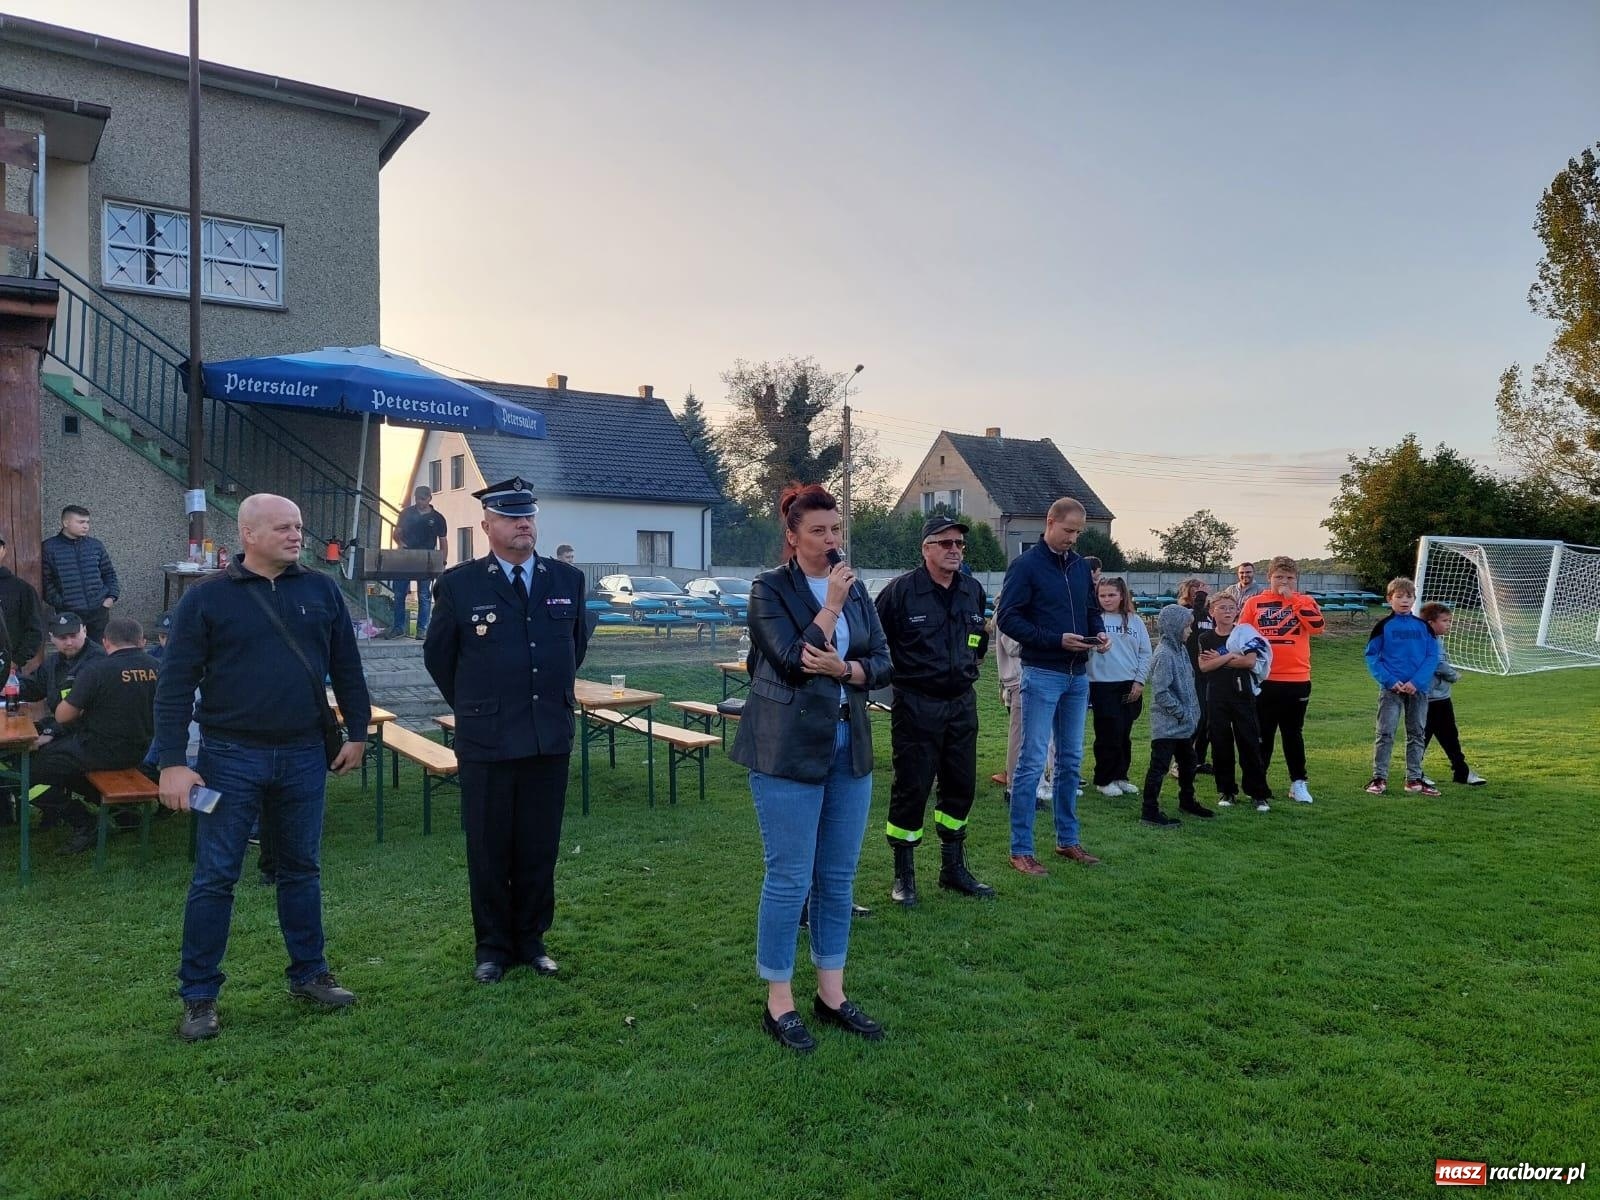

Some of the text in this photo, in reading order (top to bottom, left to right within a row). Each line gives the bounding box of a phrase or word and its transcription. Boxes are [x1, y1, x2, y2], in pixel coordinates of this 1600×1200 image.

[224, 373, 318, 397] Peterstaler
[371, 390, 469, 417] Peterstaler
[502, 407, 537, 430] Peterstaler
[121, 668, 159, 682] STRA
